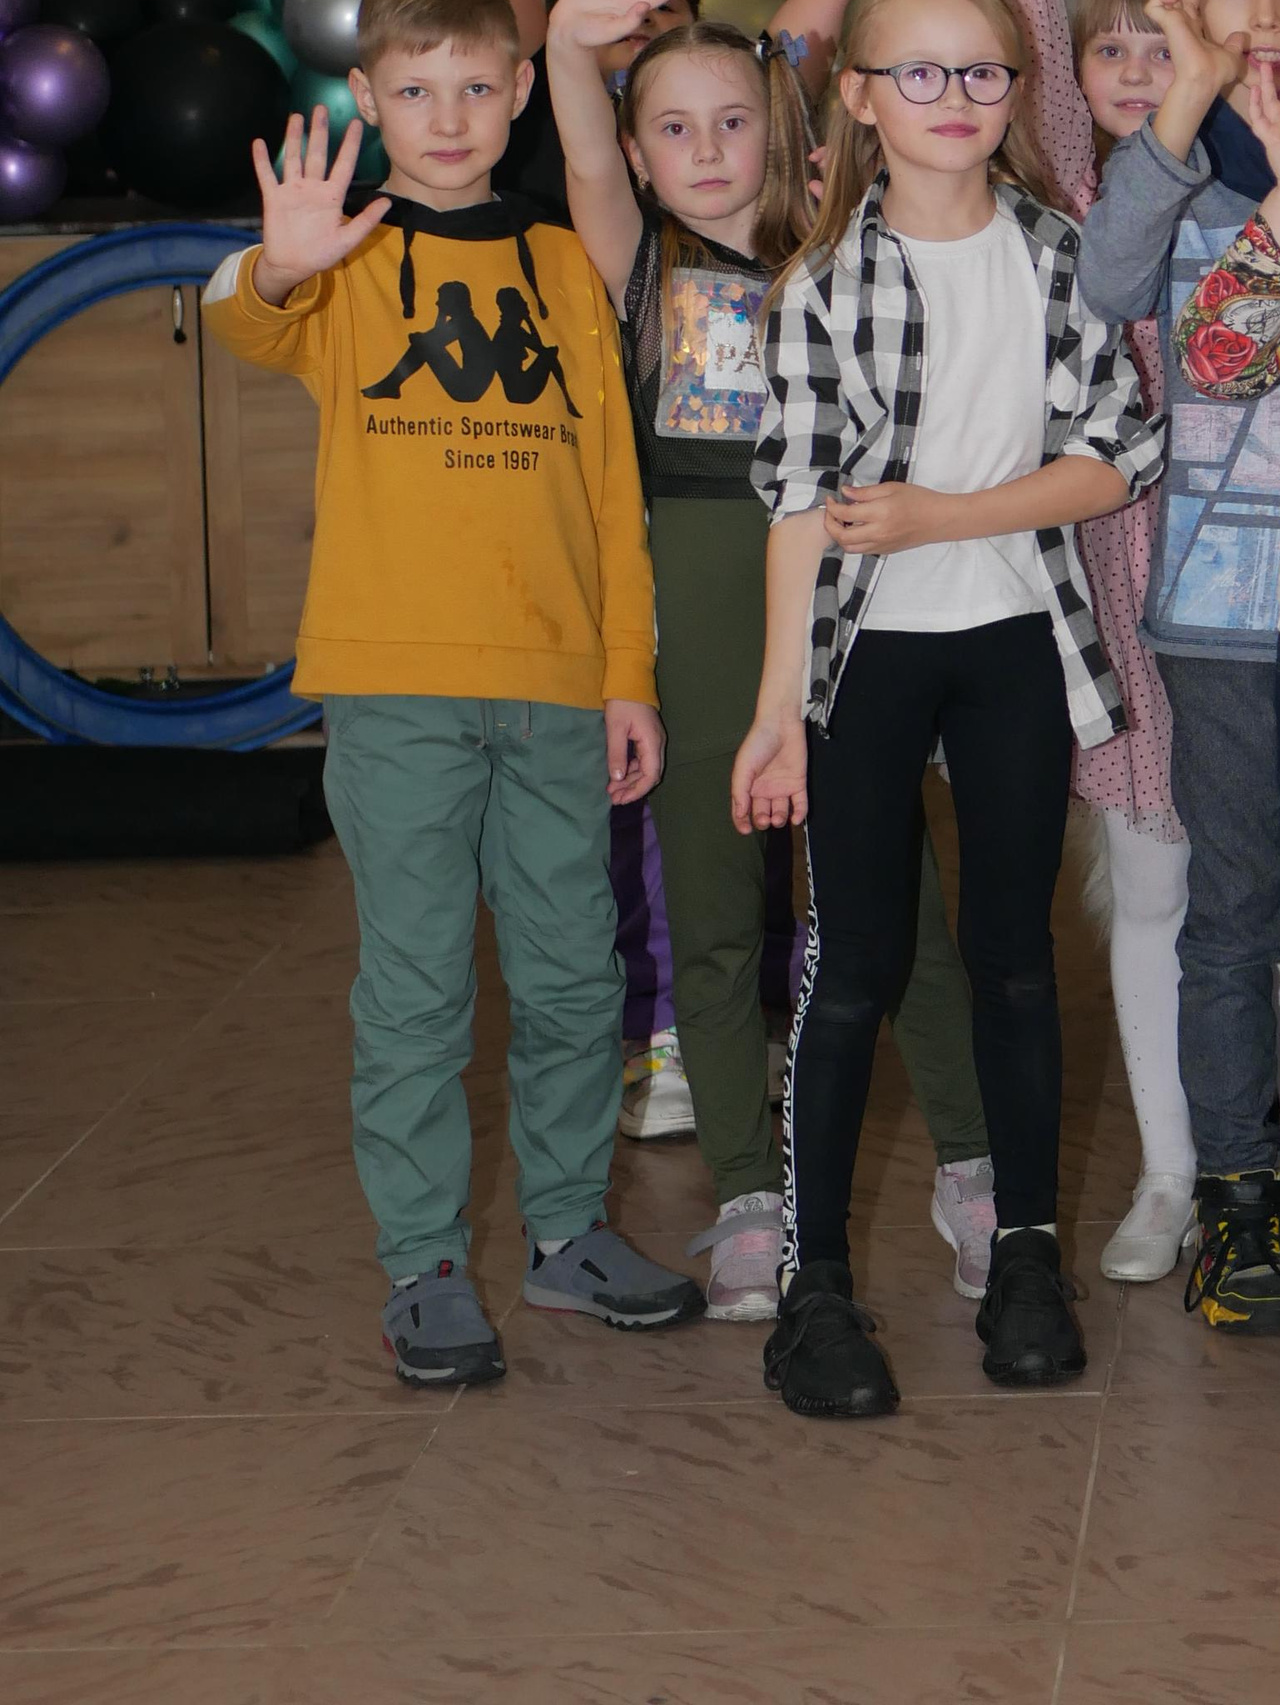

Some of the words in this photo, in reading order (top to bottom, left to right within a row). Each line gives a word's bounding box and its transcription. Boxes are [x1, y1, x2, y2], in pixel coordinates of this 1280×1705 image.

[366, 414, 453, 436] Authentic
[461, 416, 556, 441] Sportswear
[560, 424, 579, 448] Bra
[444, 449, 495, 469] Since
[502, 450, 539, 471] 1967
